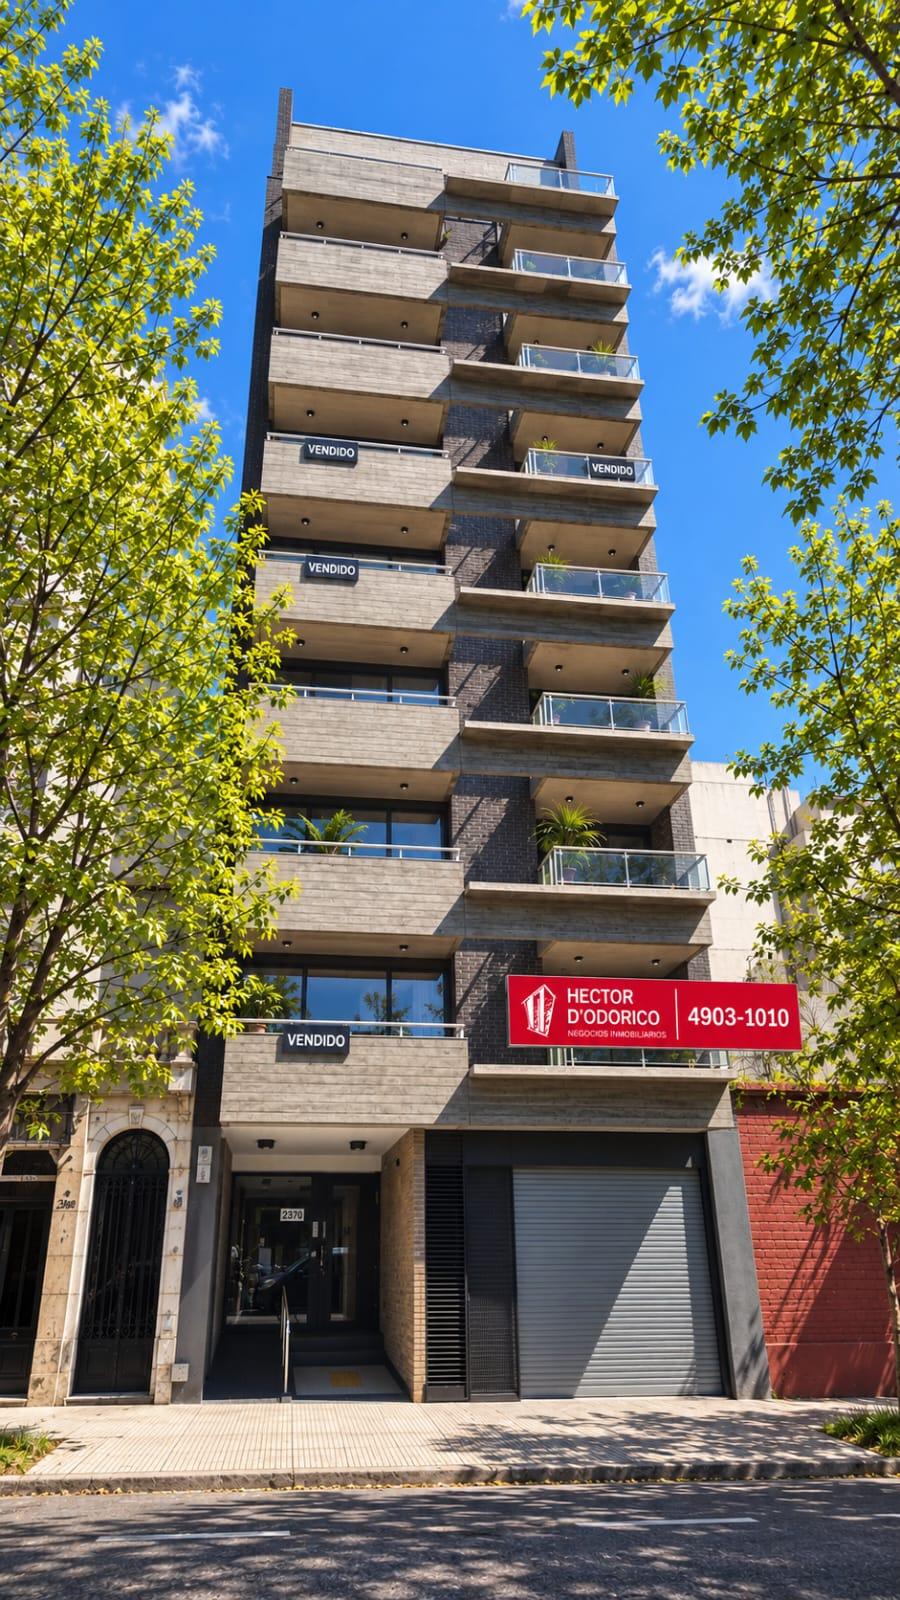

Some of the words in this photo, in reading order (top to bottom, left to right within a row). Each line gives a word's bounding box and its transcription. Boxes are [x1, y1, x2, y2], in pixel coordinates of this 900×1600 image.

[308, 444, 355, 458] VENDIDO
[592, 463, 633, 476] VENDIDO
[308, 561, 356, 576] VENDIDO
[567, 988, 634, 1005] HECTOR
[567, 1009, 660, 1026] D'ODORICO
[688, 1006, 790, 1027] 4903-1010
[287, 1033, 345, 1047] VENDIDO
[567, 1029, 609, 1038] NEGOCIOS
[610, 1030, 667, 1039] INMOBILIARIOS
[282, 1210, 303, 1220] 2370
